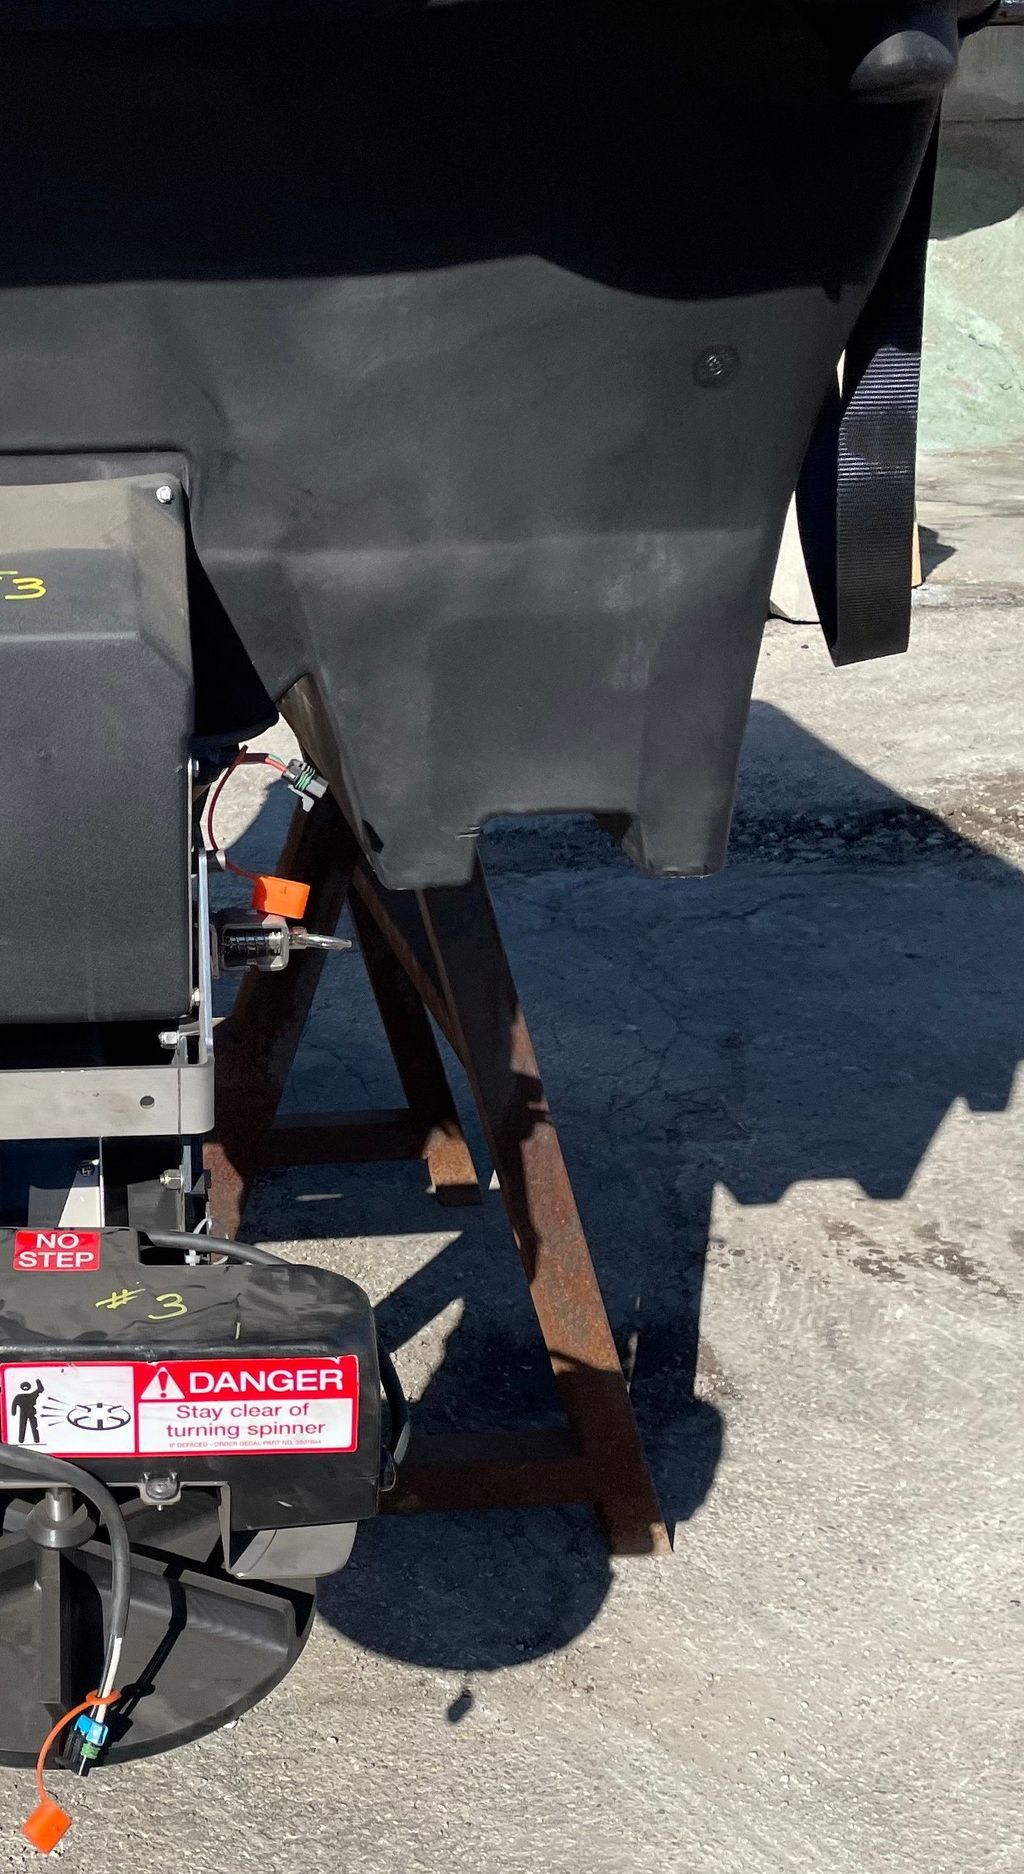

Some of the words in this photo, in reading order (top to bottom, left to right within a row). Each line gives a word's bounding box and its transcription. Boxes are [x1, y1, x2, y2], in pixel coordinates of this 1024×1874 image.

[35, 1233, 80, 1249] NO
[18, 1251, 95, 1268] STEP
[189, 1369, 344, 1394] DANGER
[176, 1404, 224, 1422] Stay
[230, 1403, 283, 1418] clear
[289, 1402, 310, 1417] of
[166, 1423, 240, 1440] turning
[247, 1421, 326, 1439] spinner
